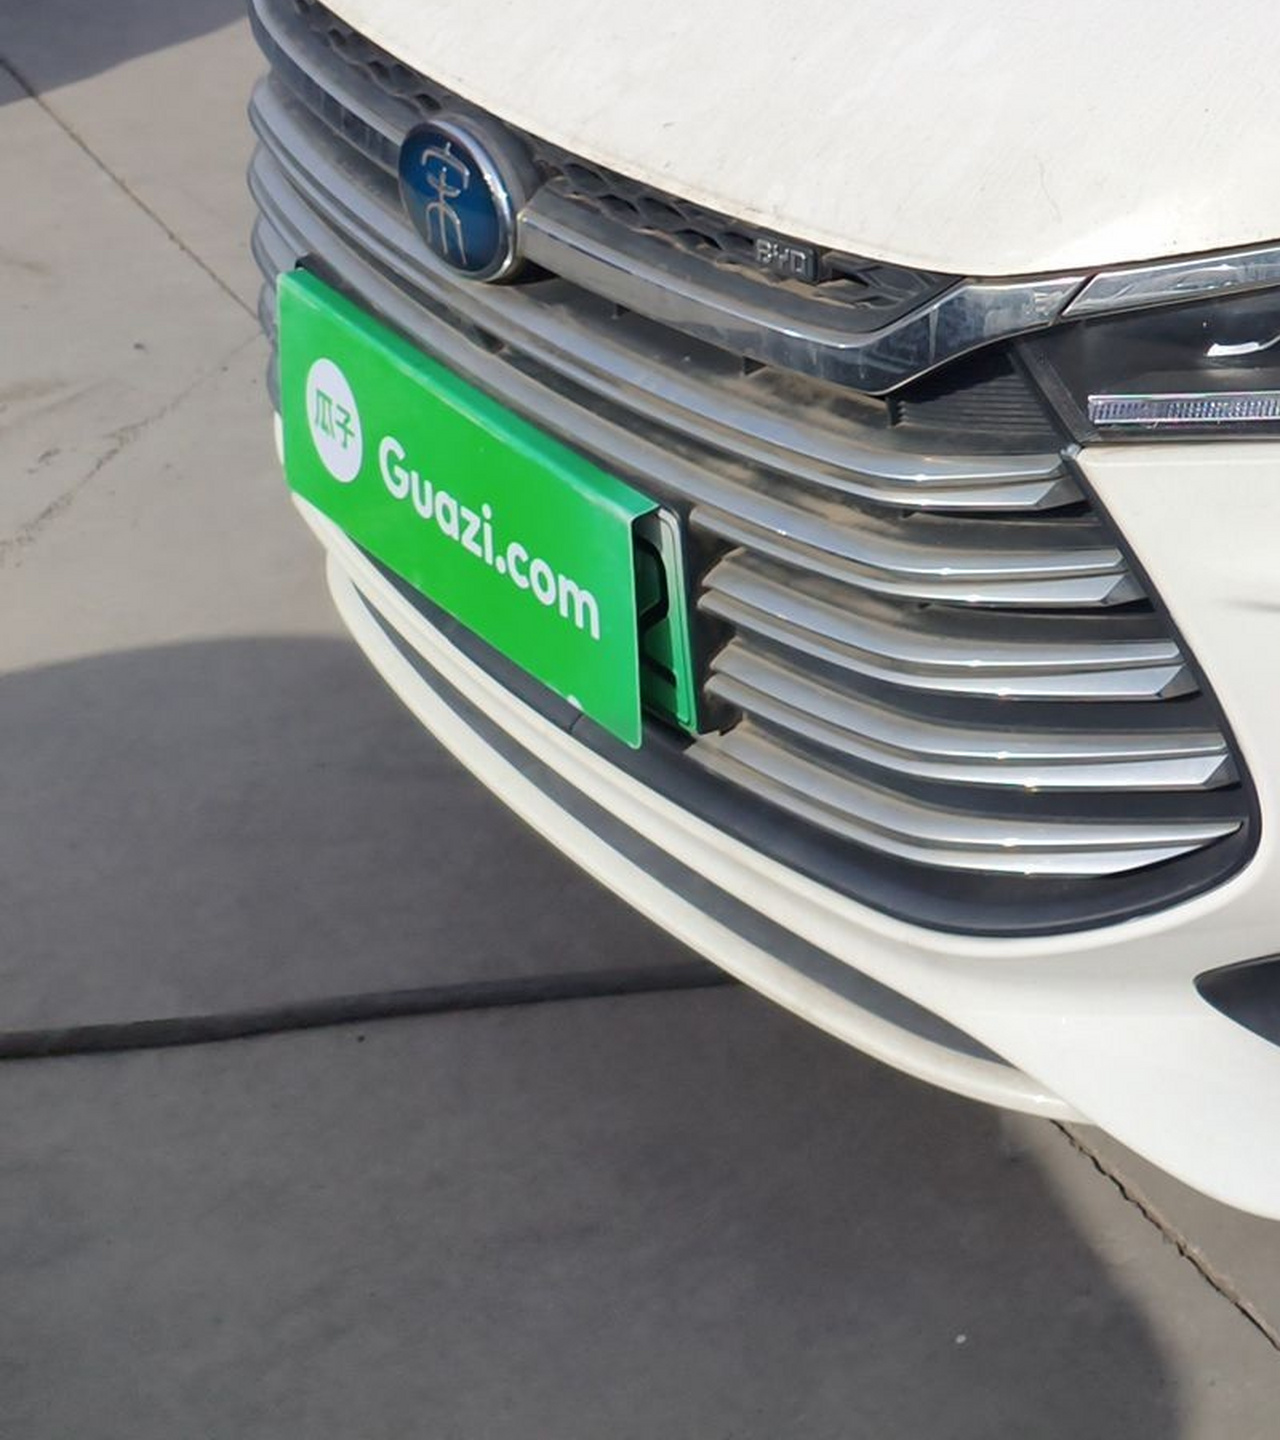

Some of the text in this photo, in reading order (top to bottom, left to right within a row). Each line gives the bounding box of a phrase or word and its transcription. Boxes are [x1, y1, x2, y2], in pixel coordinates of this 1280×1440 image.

[755, 238, 807, 276] BYD
[313, 387, 356, 450] 瓜子
[378, 435, 601, 641] Guazi.com
